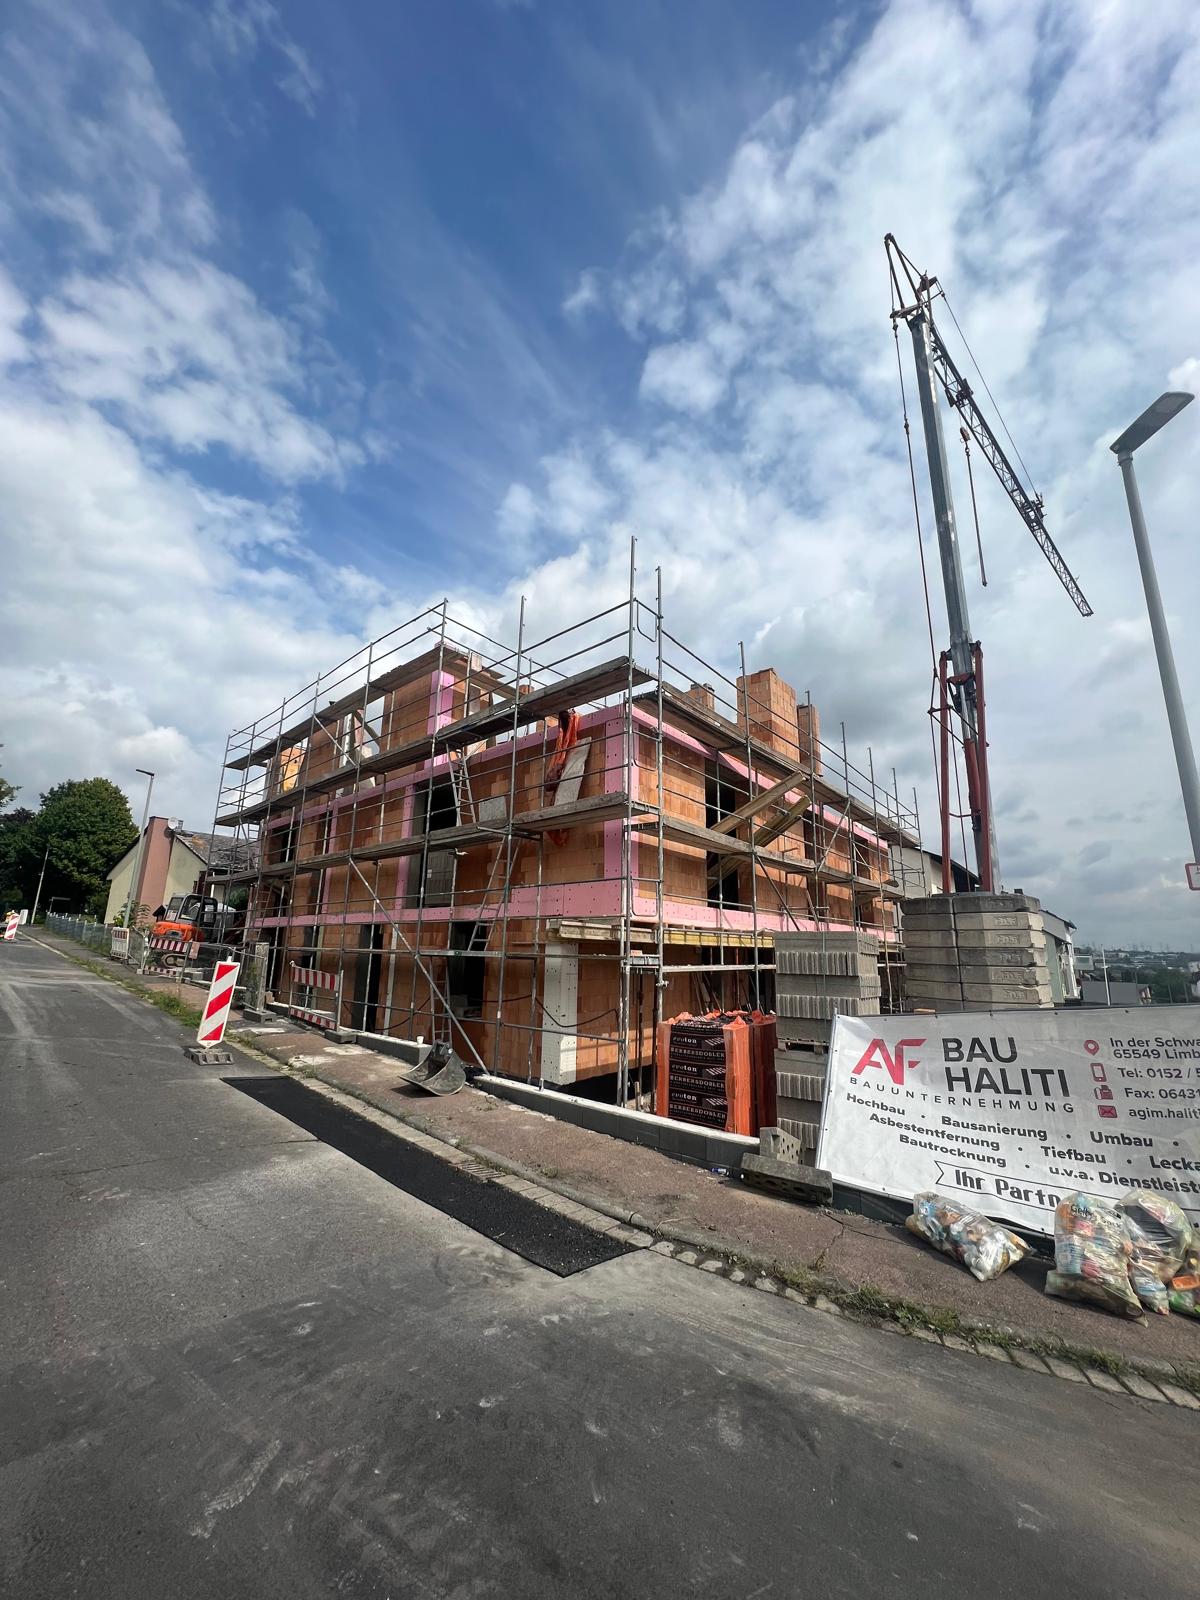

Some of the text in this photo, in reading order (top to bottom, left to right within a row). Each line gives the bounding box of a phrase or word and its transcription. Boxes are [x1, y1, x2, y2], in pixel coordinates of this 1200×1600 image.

[941, 1036, 1018, 1063] BAU
[1109, 1037, 1124, 1048] In
[1127, 1037, 1151, 1048] der
[1113, 1048, 1200, 1059] 65549 Limb
[944, 1066, 1071, 1098] HALITI
[1117, 1067, 1143, 1078] Tel:
[1146, 1068, 1183, 1079] 0152
[1186, 1067, 1191, 1079] /
[849, 1076, 1074, 1113] BAUUNTERNEHMUNG
[1124, 1087, 1155, 1099] Fax:
[846, 1092, 1154, 1147] Hochbau Bausanierung Umbau
[869, 1112, 1000, 1152] Asbestentfernung
[1040, 1145, 1107, 1164] Tiefbau
[899, 1133, 1200, 1194] Bautrocknung u.v.a. Dienstleist
[954, 1169, 1062, 1208] Ihr Partn
